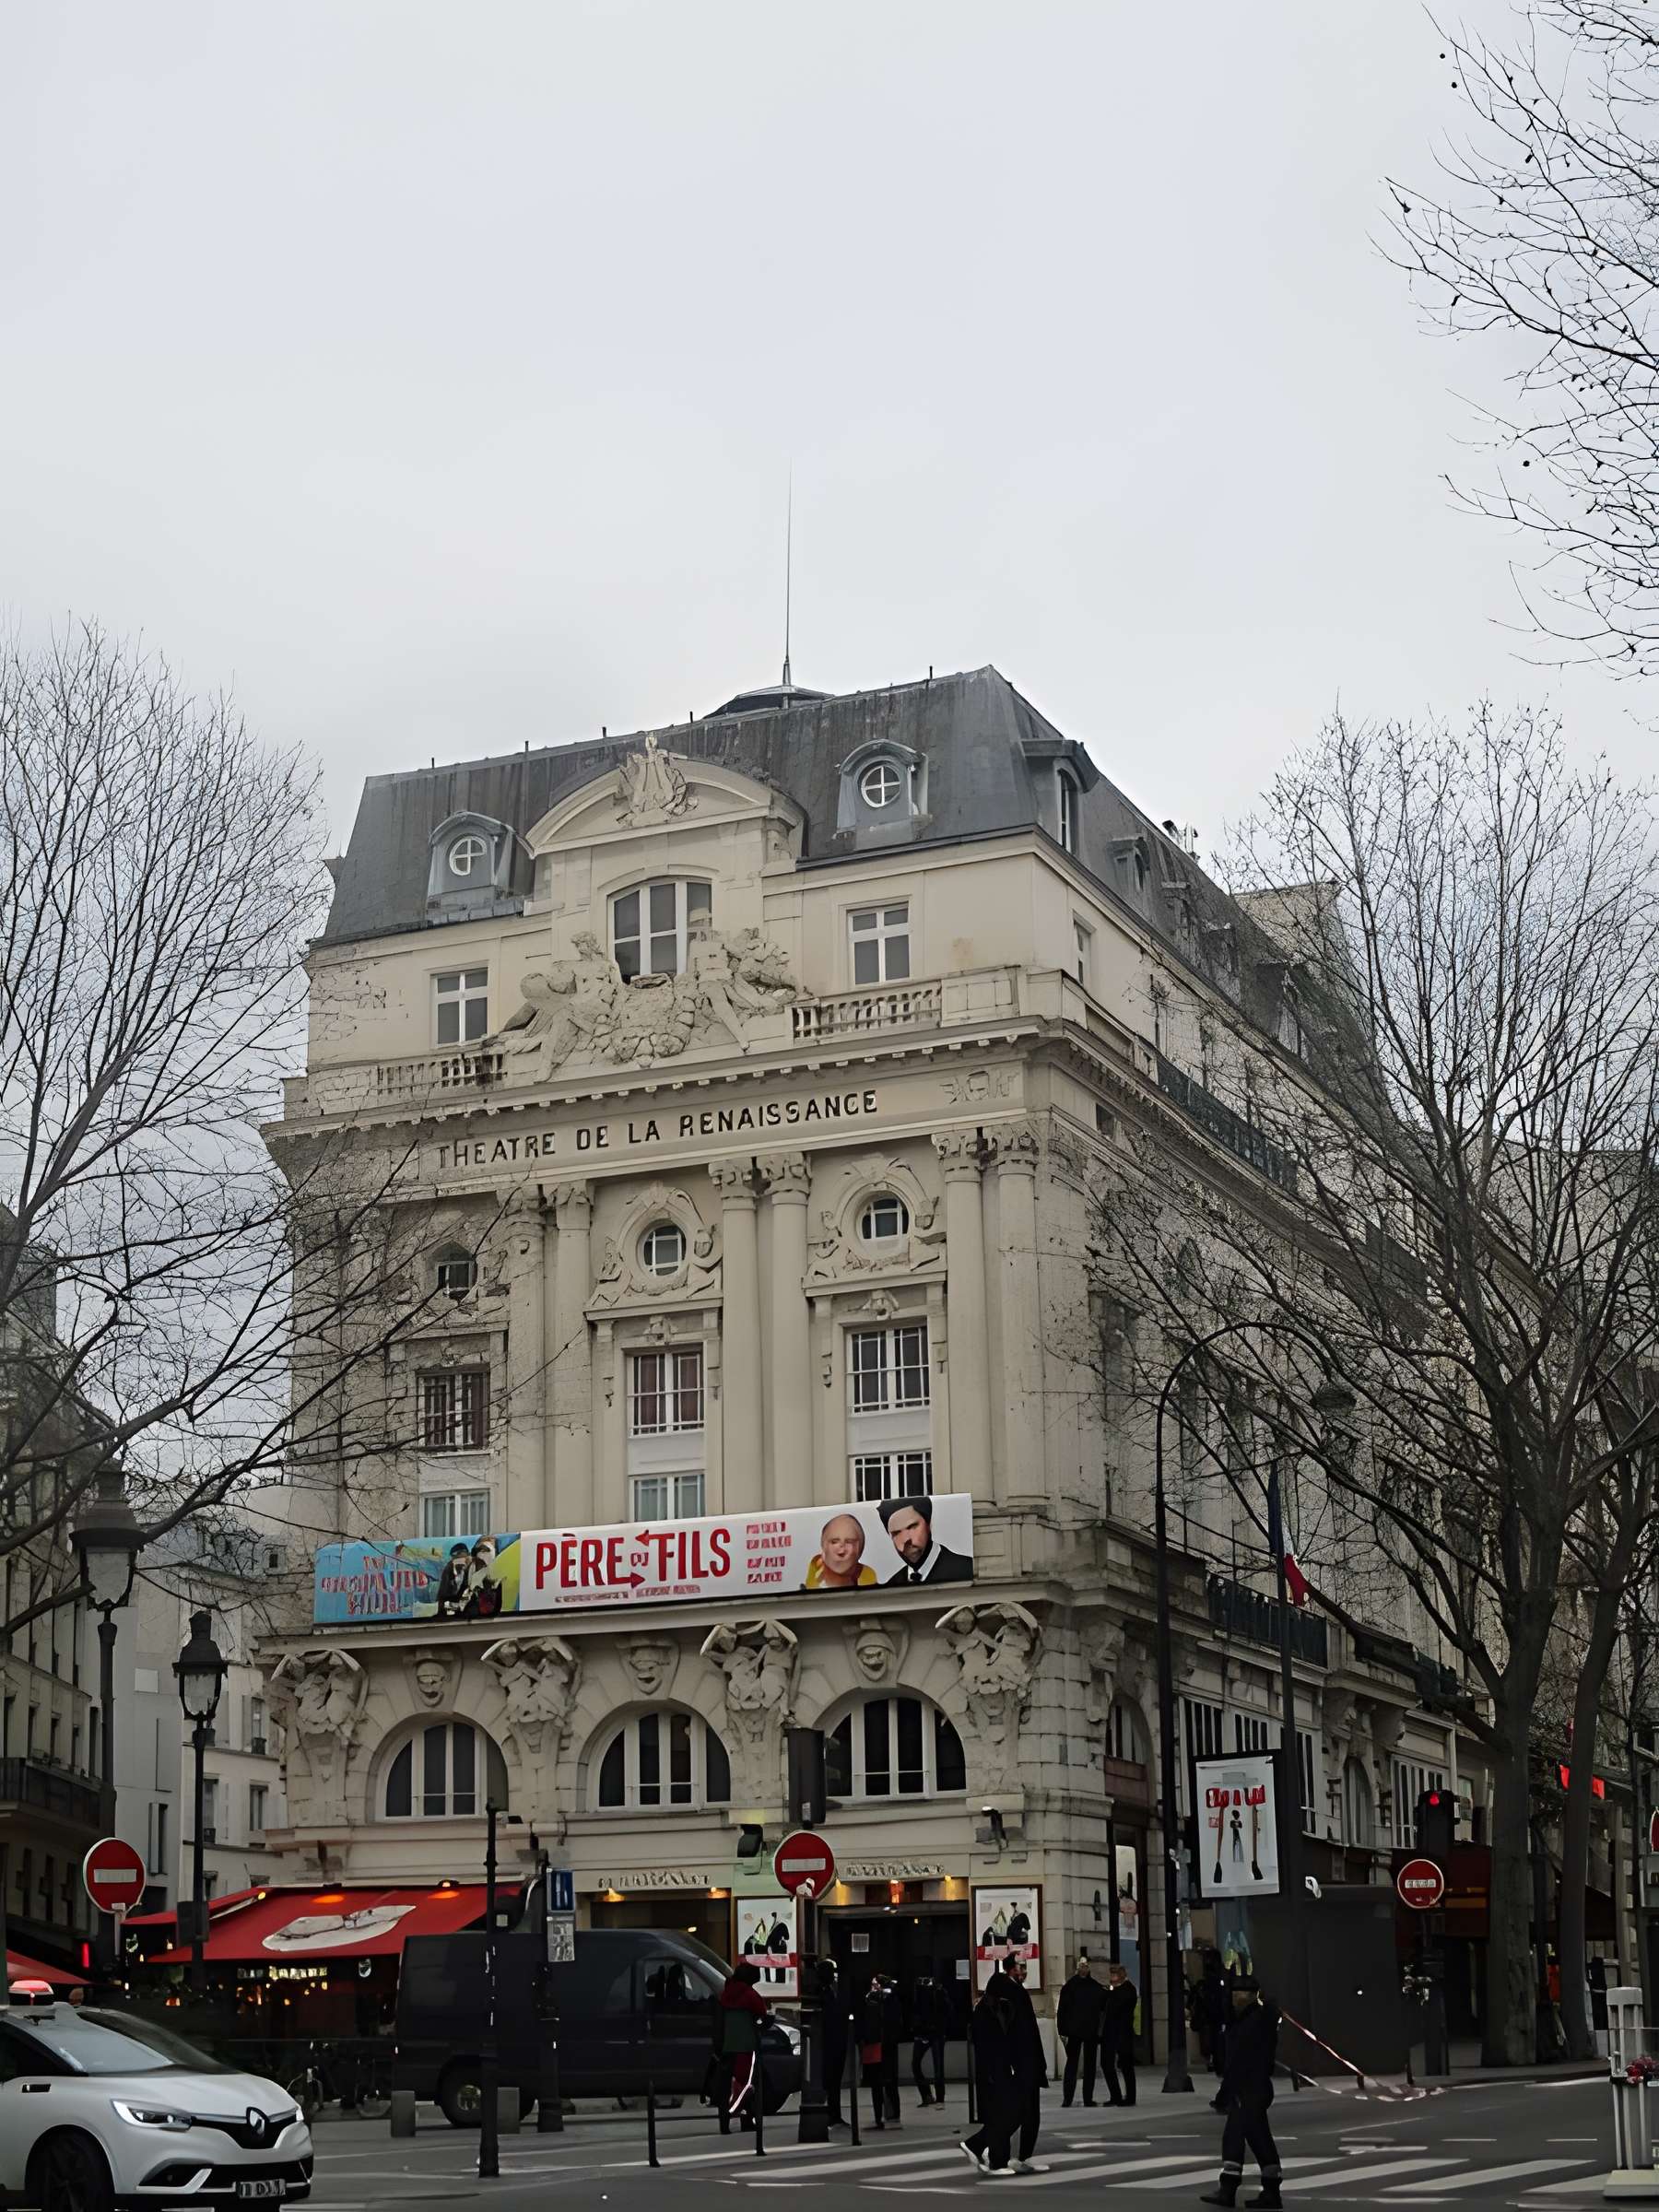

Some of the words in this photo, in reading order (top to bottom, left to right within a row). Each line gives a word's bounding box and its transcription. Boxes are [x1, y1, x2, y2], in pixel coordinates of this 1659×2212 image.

[434, 1132, 556, 1169] THEATRE
[576, 1124, 609, 1150] DE
[628, 1120, 660, 1144] LA
[679, 1089, 877, 1137] RENAISSANCE
[535, 1533, 627, 1590] PÈRE
[645, 1528, 731, 1582] FILS
